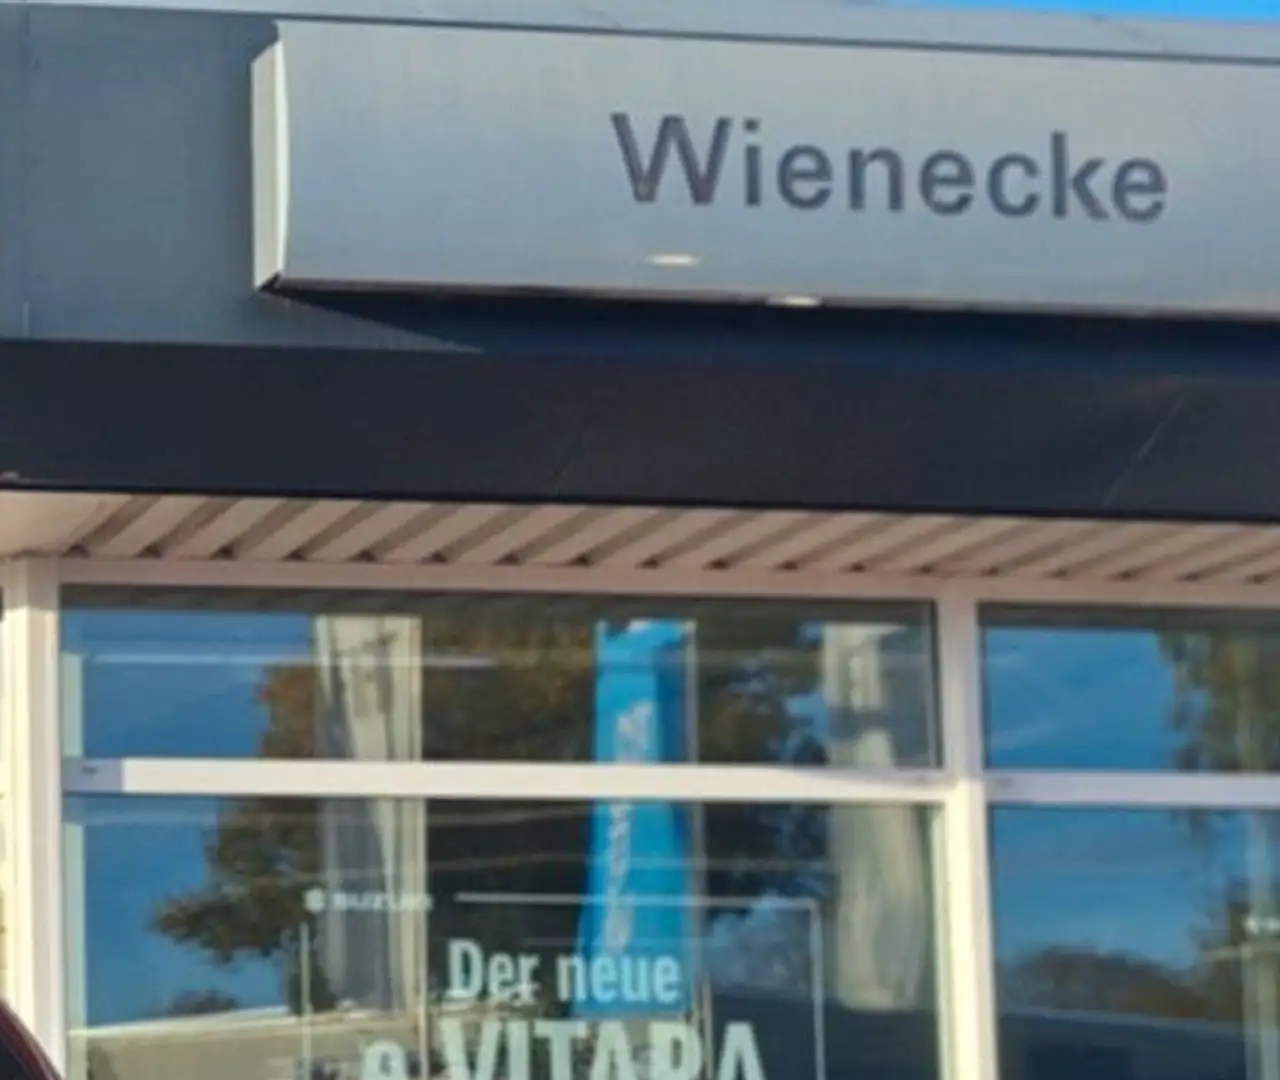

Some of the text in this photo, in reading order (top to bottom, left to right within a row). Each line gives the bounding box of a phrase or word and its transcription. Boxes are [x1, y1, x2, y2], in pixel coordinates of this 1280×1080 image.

[610, 111, 1168, 224] Wienecke
[446, 937, 681, 1002] Der neue
